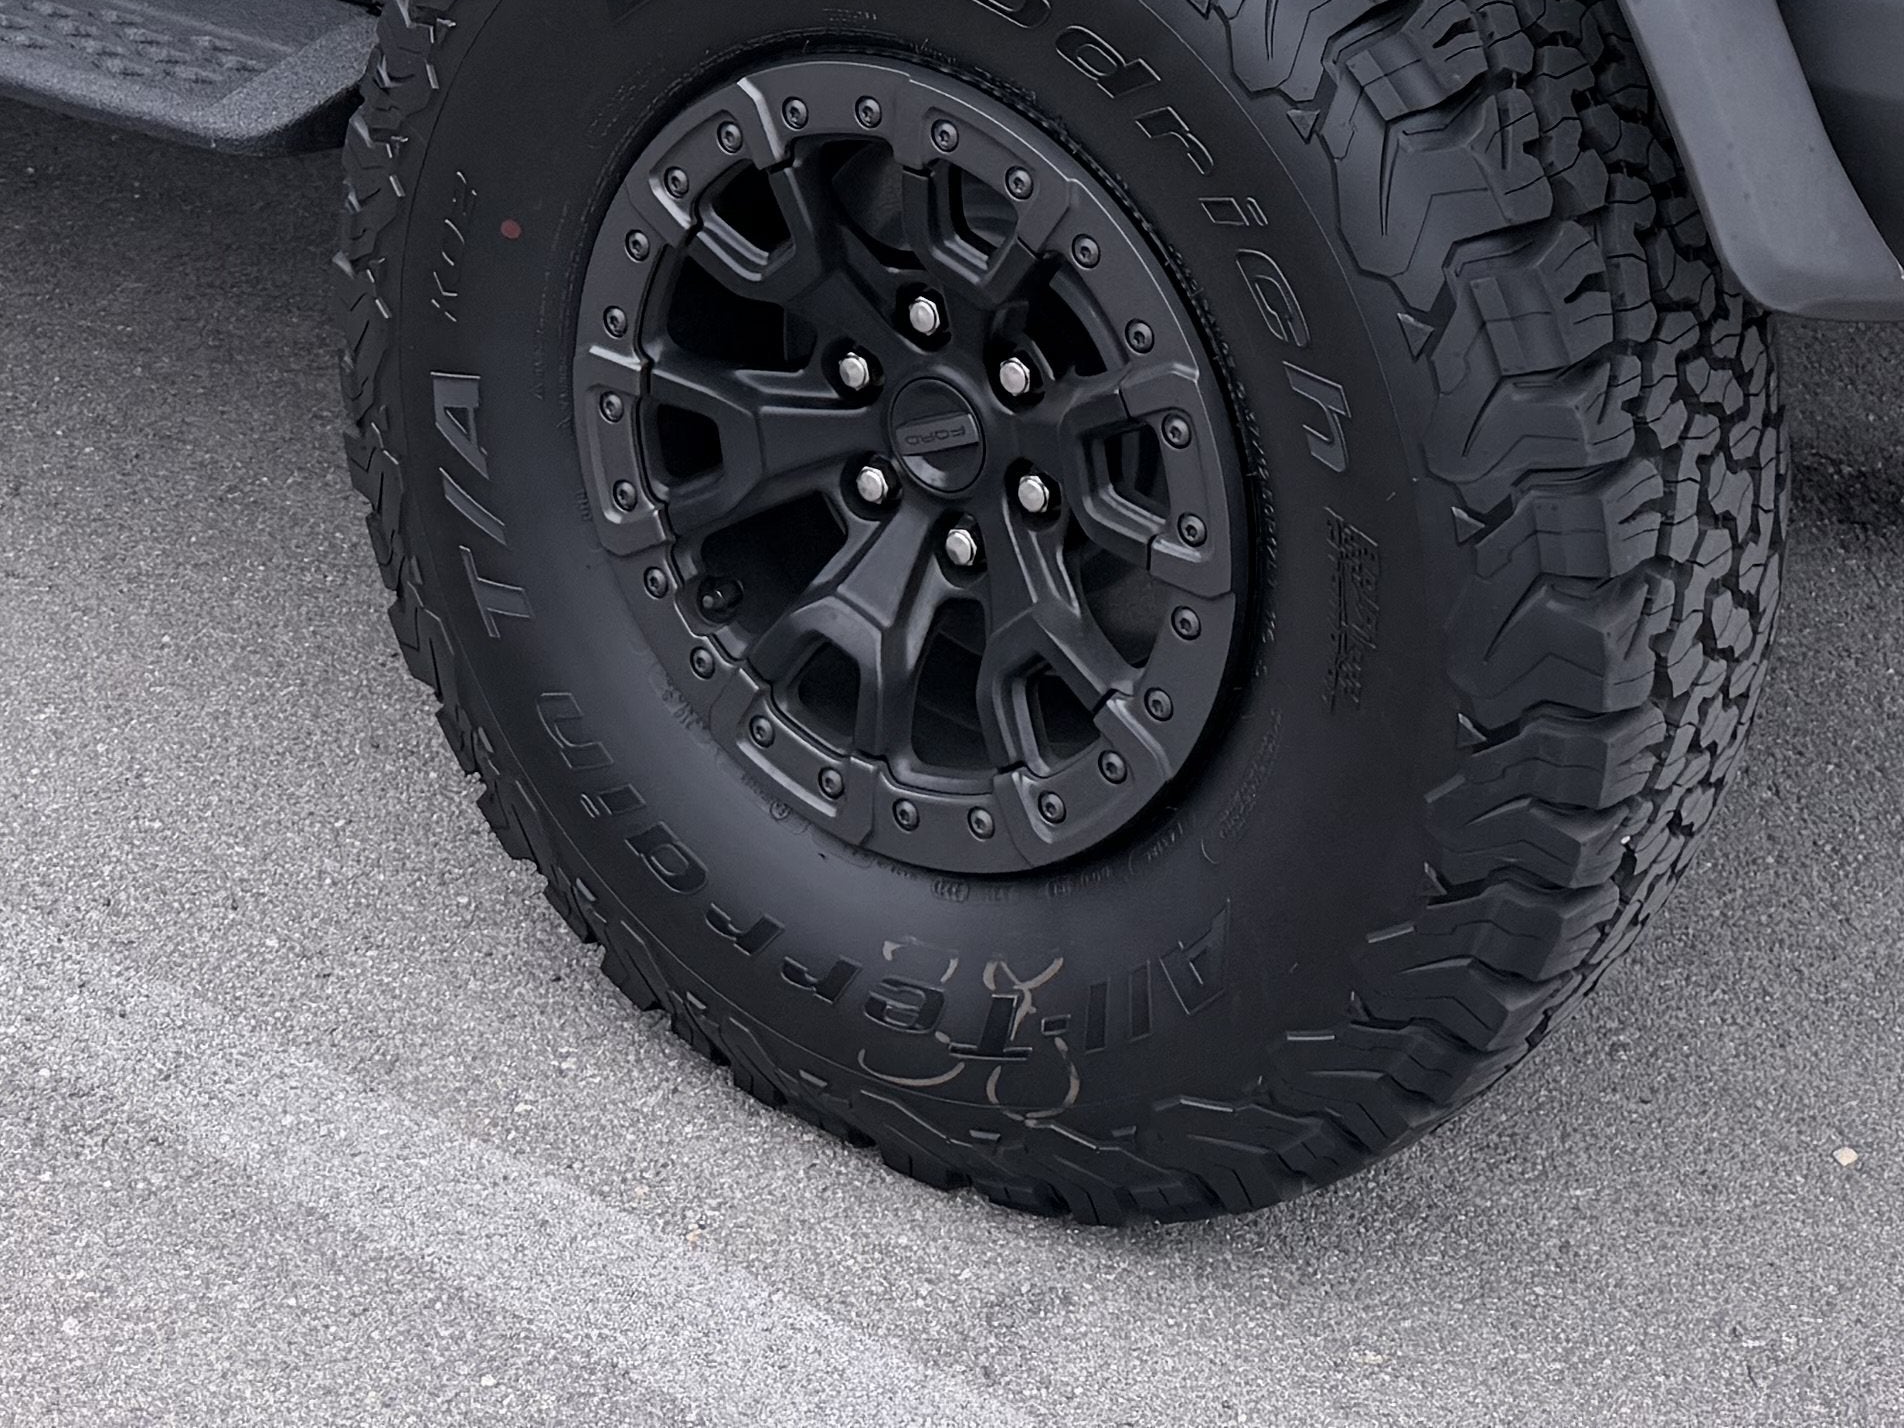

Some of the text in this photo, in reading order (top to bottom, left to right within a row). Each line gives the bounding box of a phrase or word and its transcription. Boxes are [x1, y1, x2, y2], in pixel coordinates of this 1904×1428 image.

[427, 369, 536, 639] T/A
[904, 424, 967, 446] FORD
[534, 689, 1232, 1062] All-Terrain
